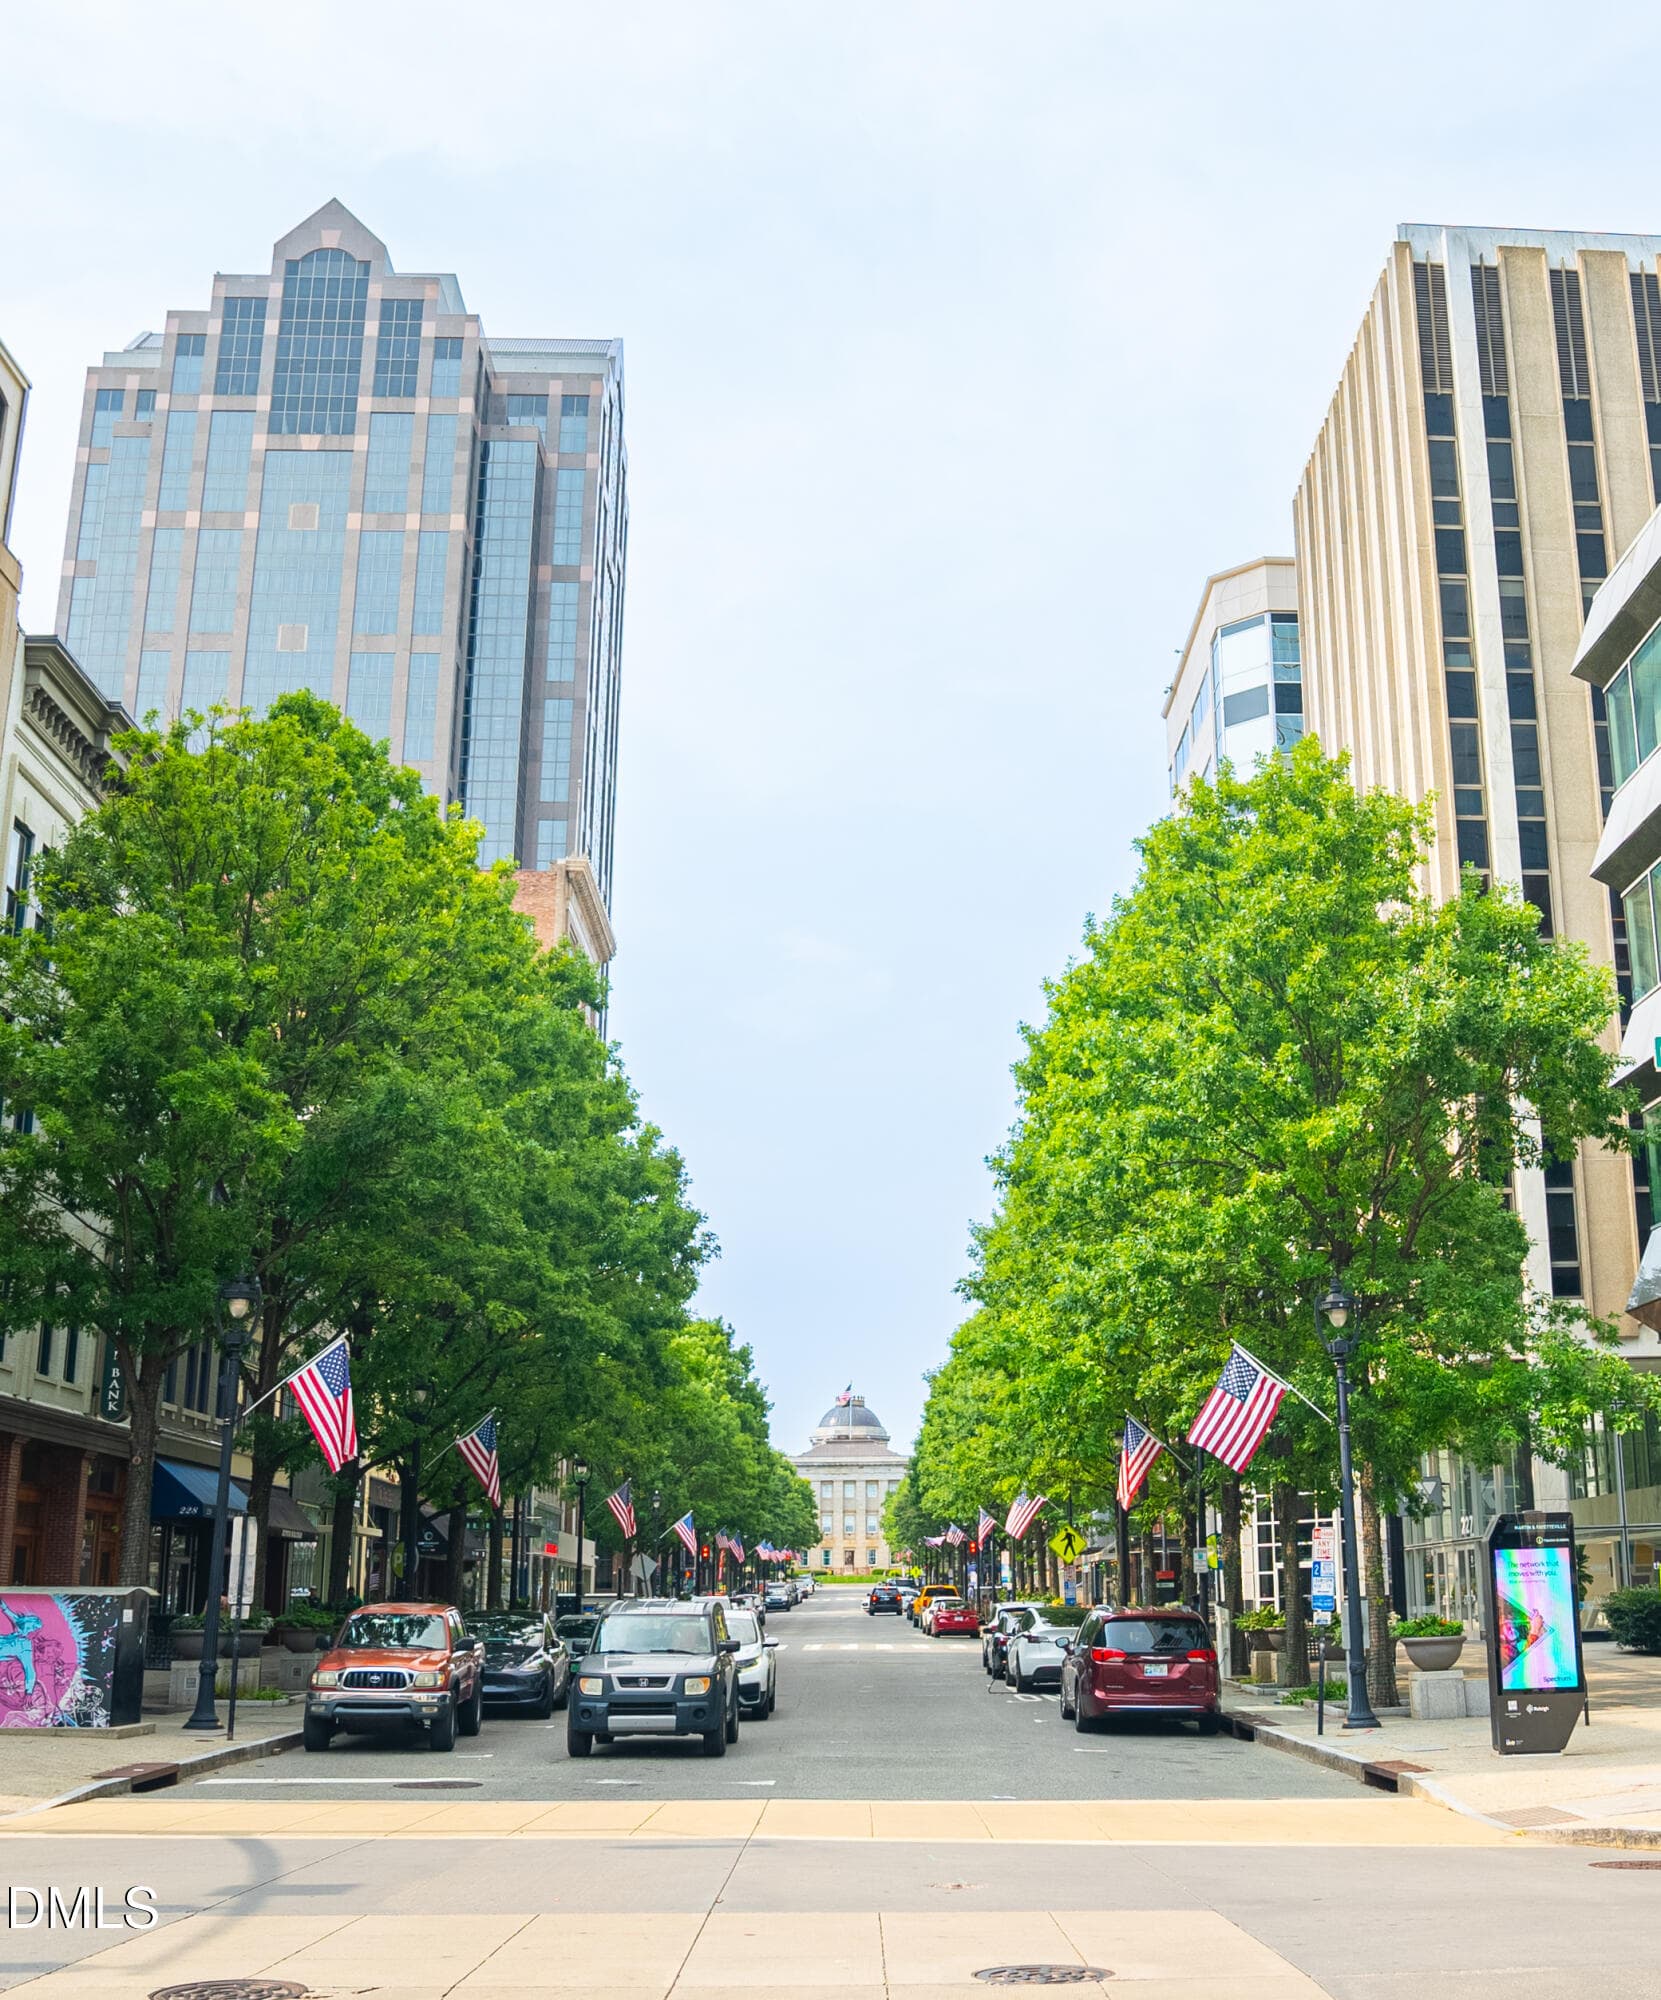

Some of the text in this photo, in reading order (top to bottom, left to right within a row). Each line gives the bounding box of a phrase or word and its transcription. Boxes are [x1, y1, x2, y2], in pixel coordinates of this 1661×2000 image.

[108, 1368, 120, 1411] BANK
[179, 1506, 199, 1514] 228
[1314, 1564, 1319, 1575] 2
